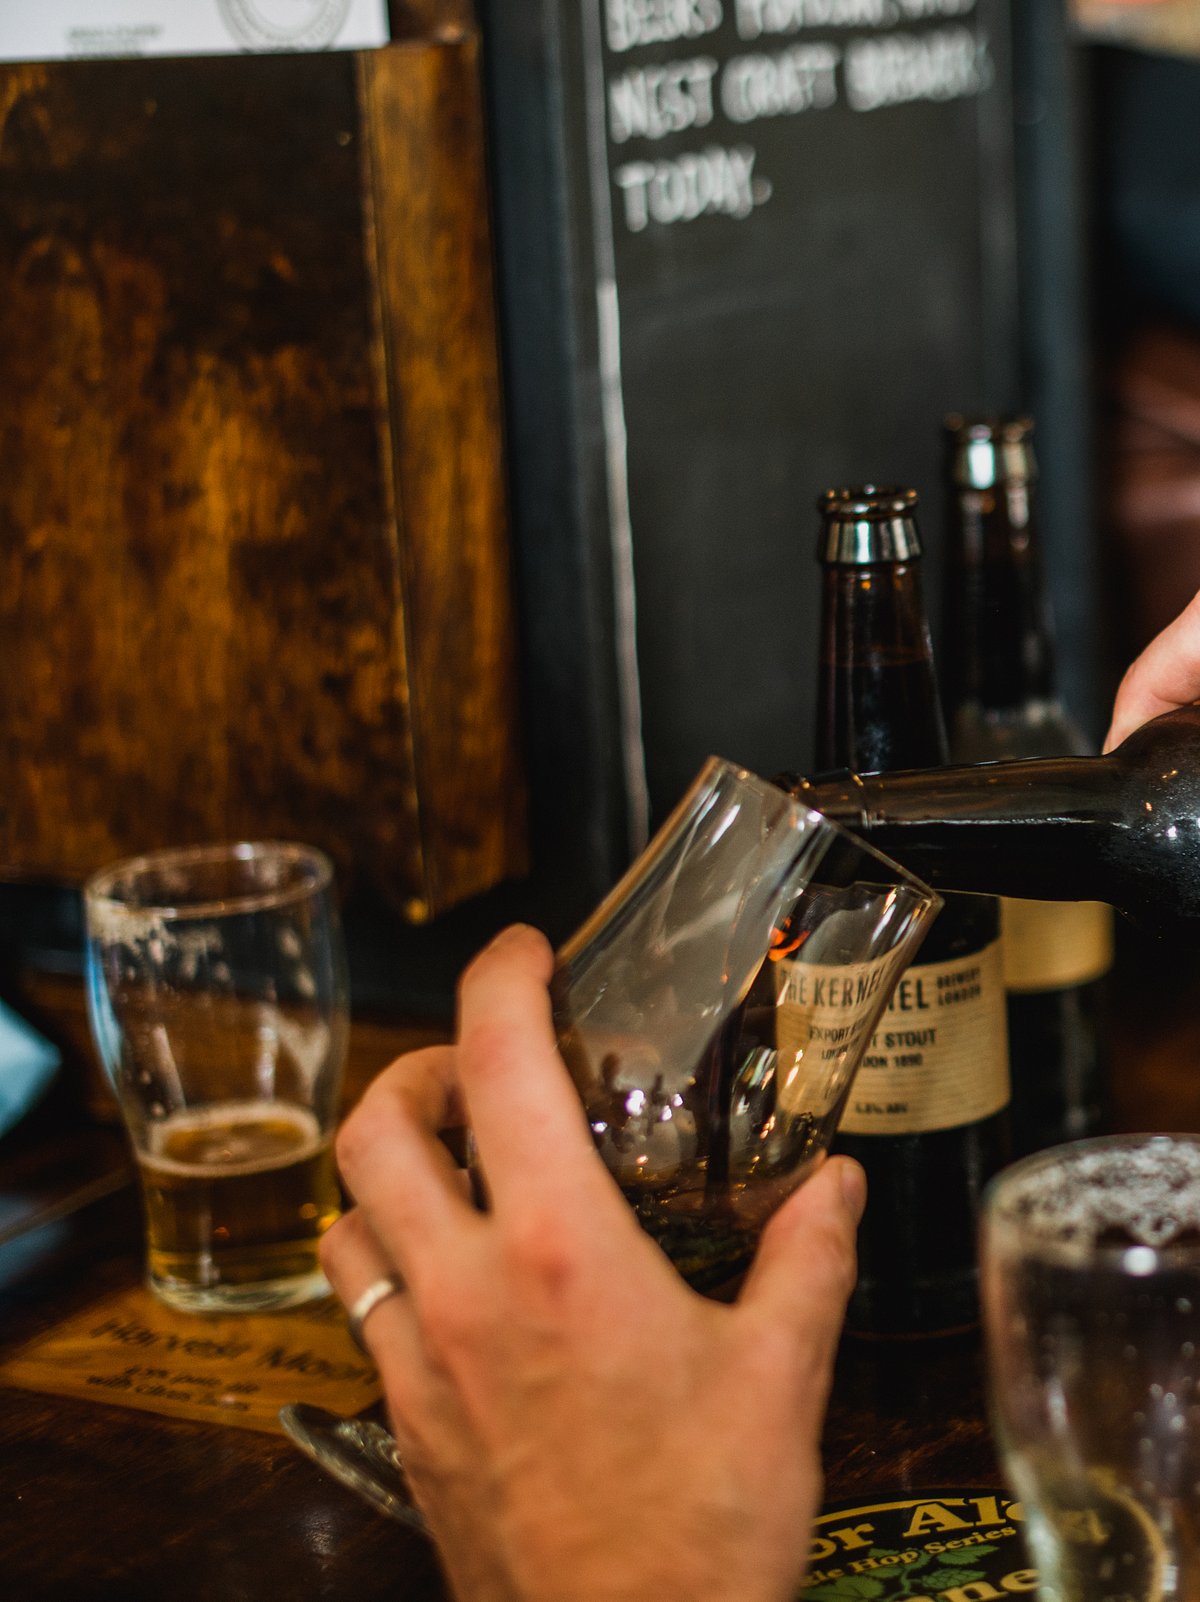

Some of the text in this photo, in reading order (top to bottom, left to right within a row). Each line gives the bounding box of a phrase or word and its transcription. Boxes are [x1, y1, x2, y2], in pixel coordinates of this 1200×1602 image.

[884, 1028, 937, 1048] STOUT
[848, 1550, 919, 1574] Hop
[924, 1526, 1017, 1555] Series
